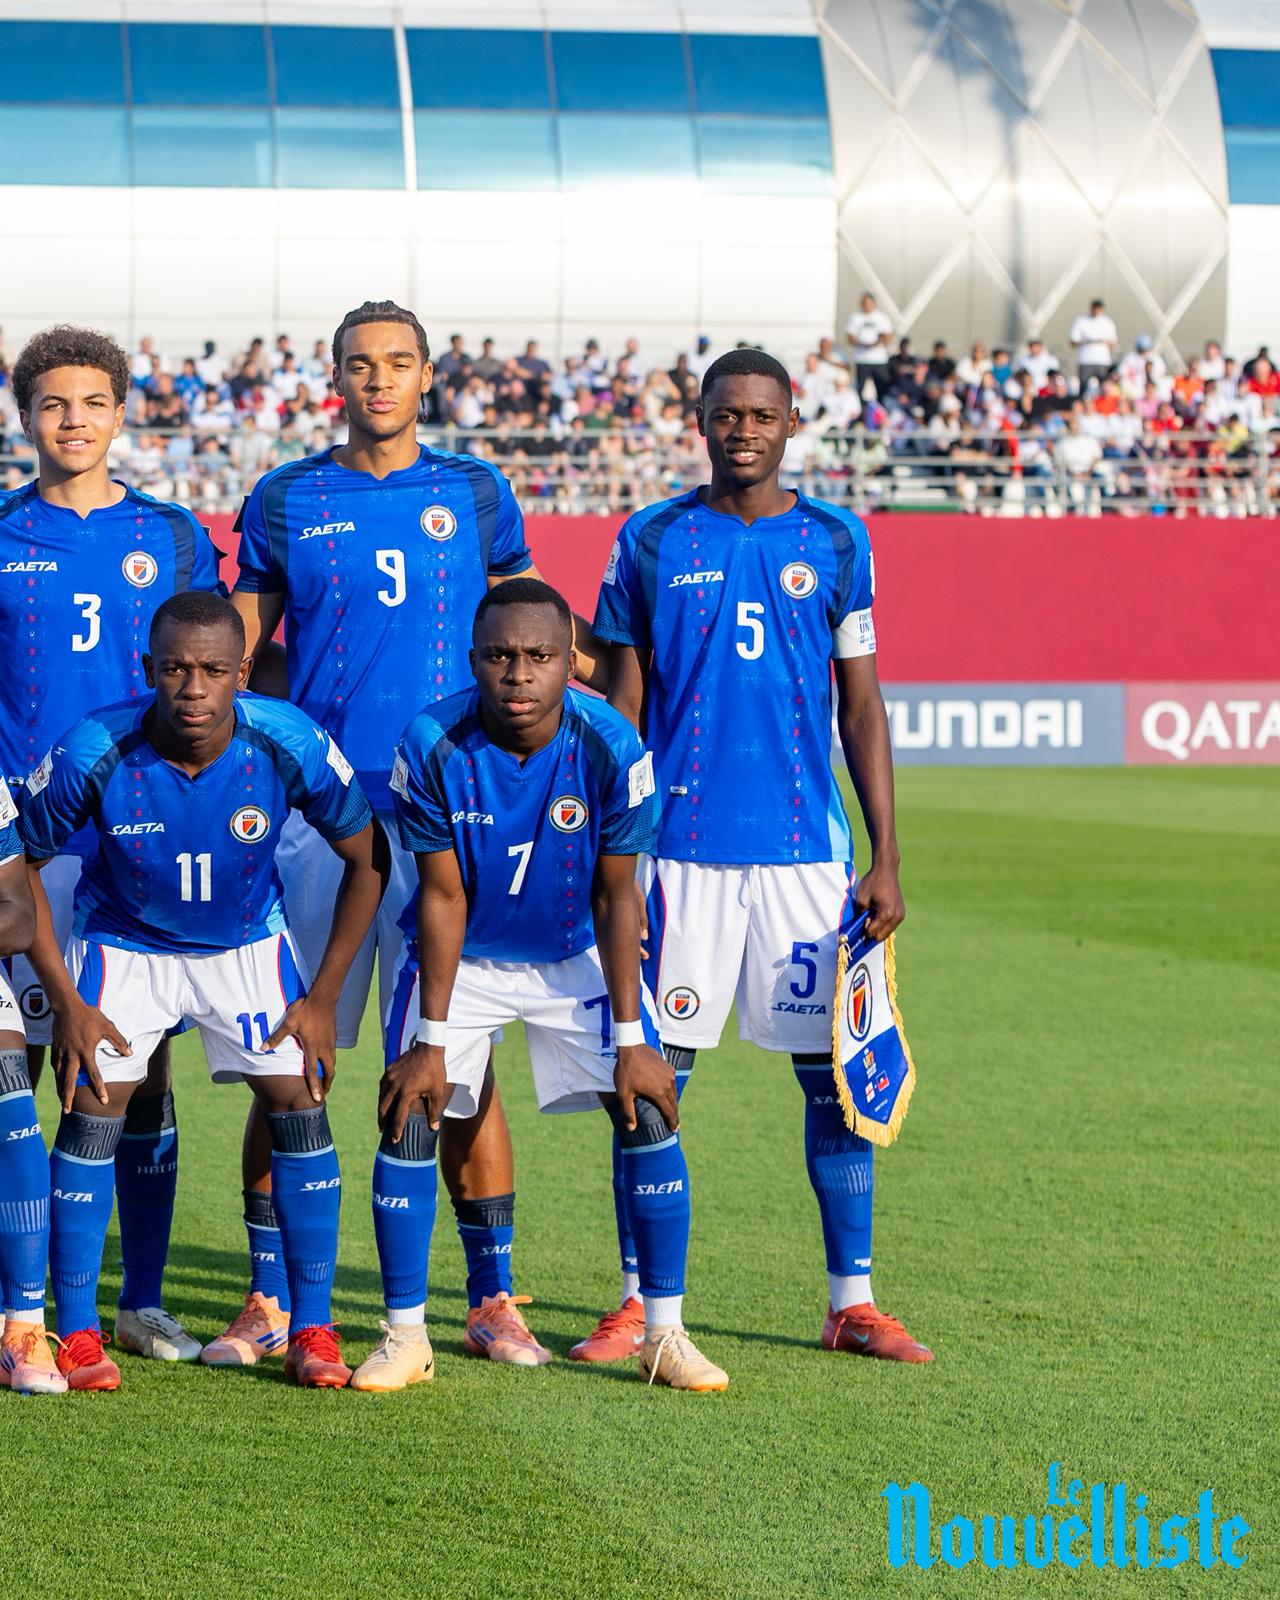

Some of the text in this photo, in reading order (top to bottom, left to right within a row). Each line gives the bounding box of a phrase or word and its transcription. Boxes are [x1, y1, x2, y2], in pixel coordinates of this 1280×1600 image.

[298, 521, 356, 540] SAETA
[1, 560, 58, 573] SAETA
[376, 549, 407, 608] 9
[669, 569, 724, 588] SAETA
[72, 592, 102, 652] 3
[736, 601, 765, 661] 5
[832, 701, 1082, 748] UNDAI
[107, 822, 165, 836] SAETA
[176, 852, 211, 902] 11
[508, 841, 534, 895] 7
[790, 941, 819, 999] 5
[772, 1001, 827, 1015] SAETA
[237, 1012, 276, 1054] 11
[53, 1188, 93, 1203] AETA
[633, 1179, 683, 1195] SAETA
